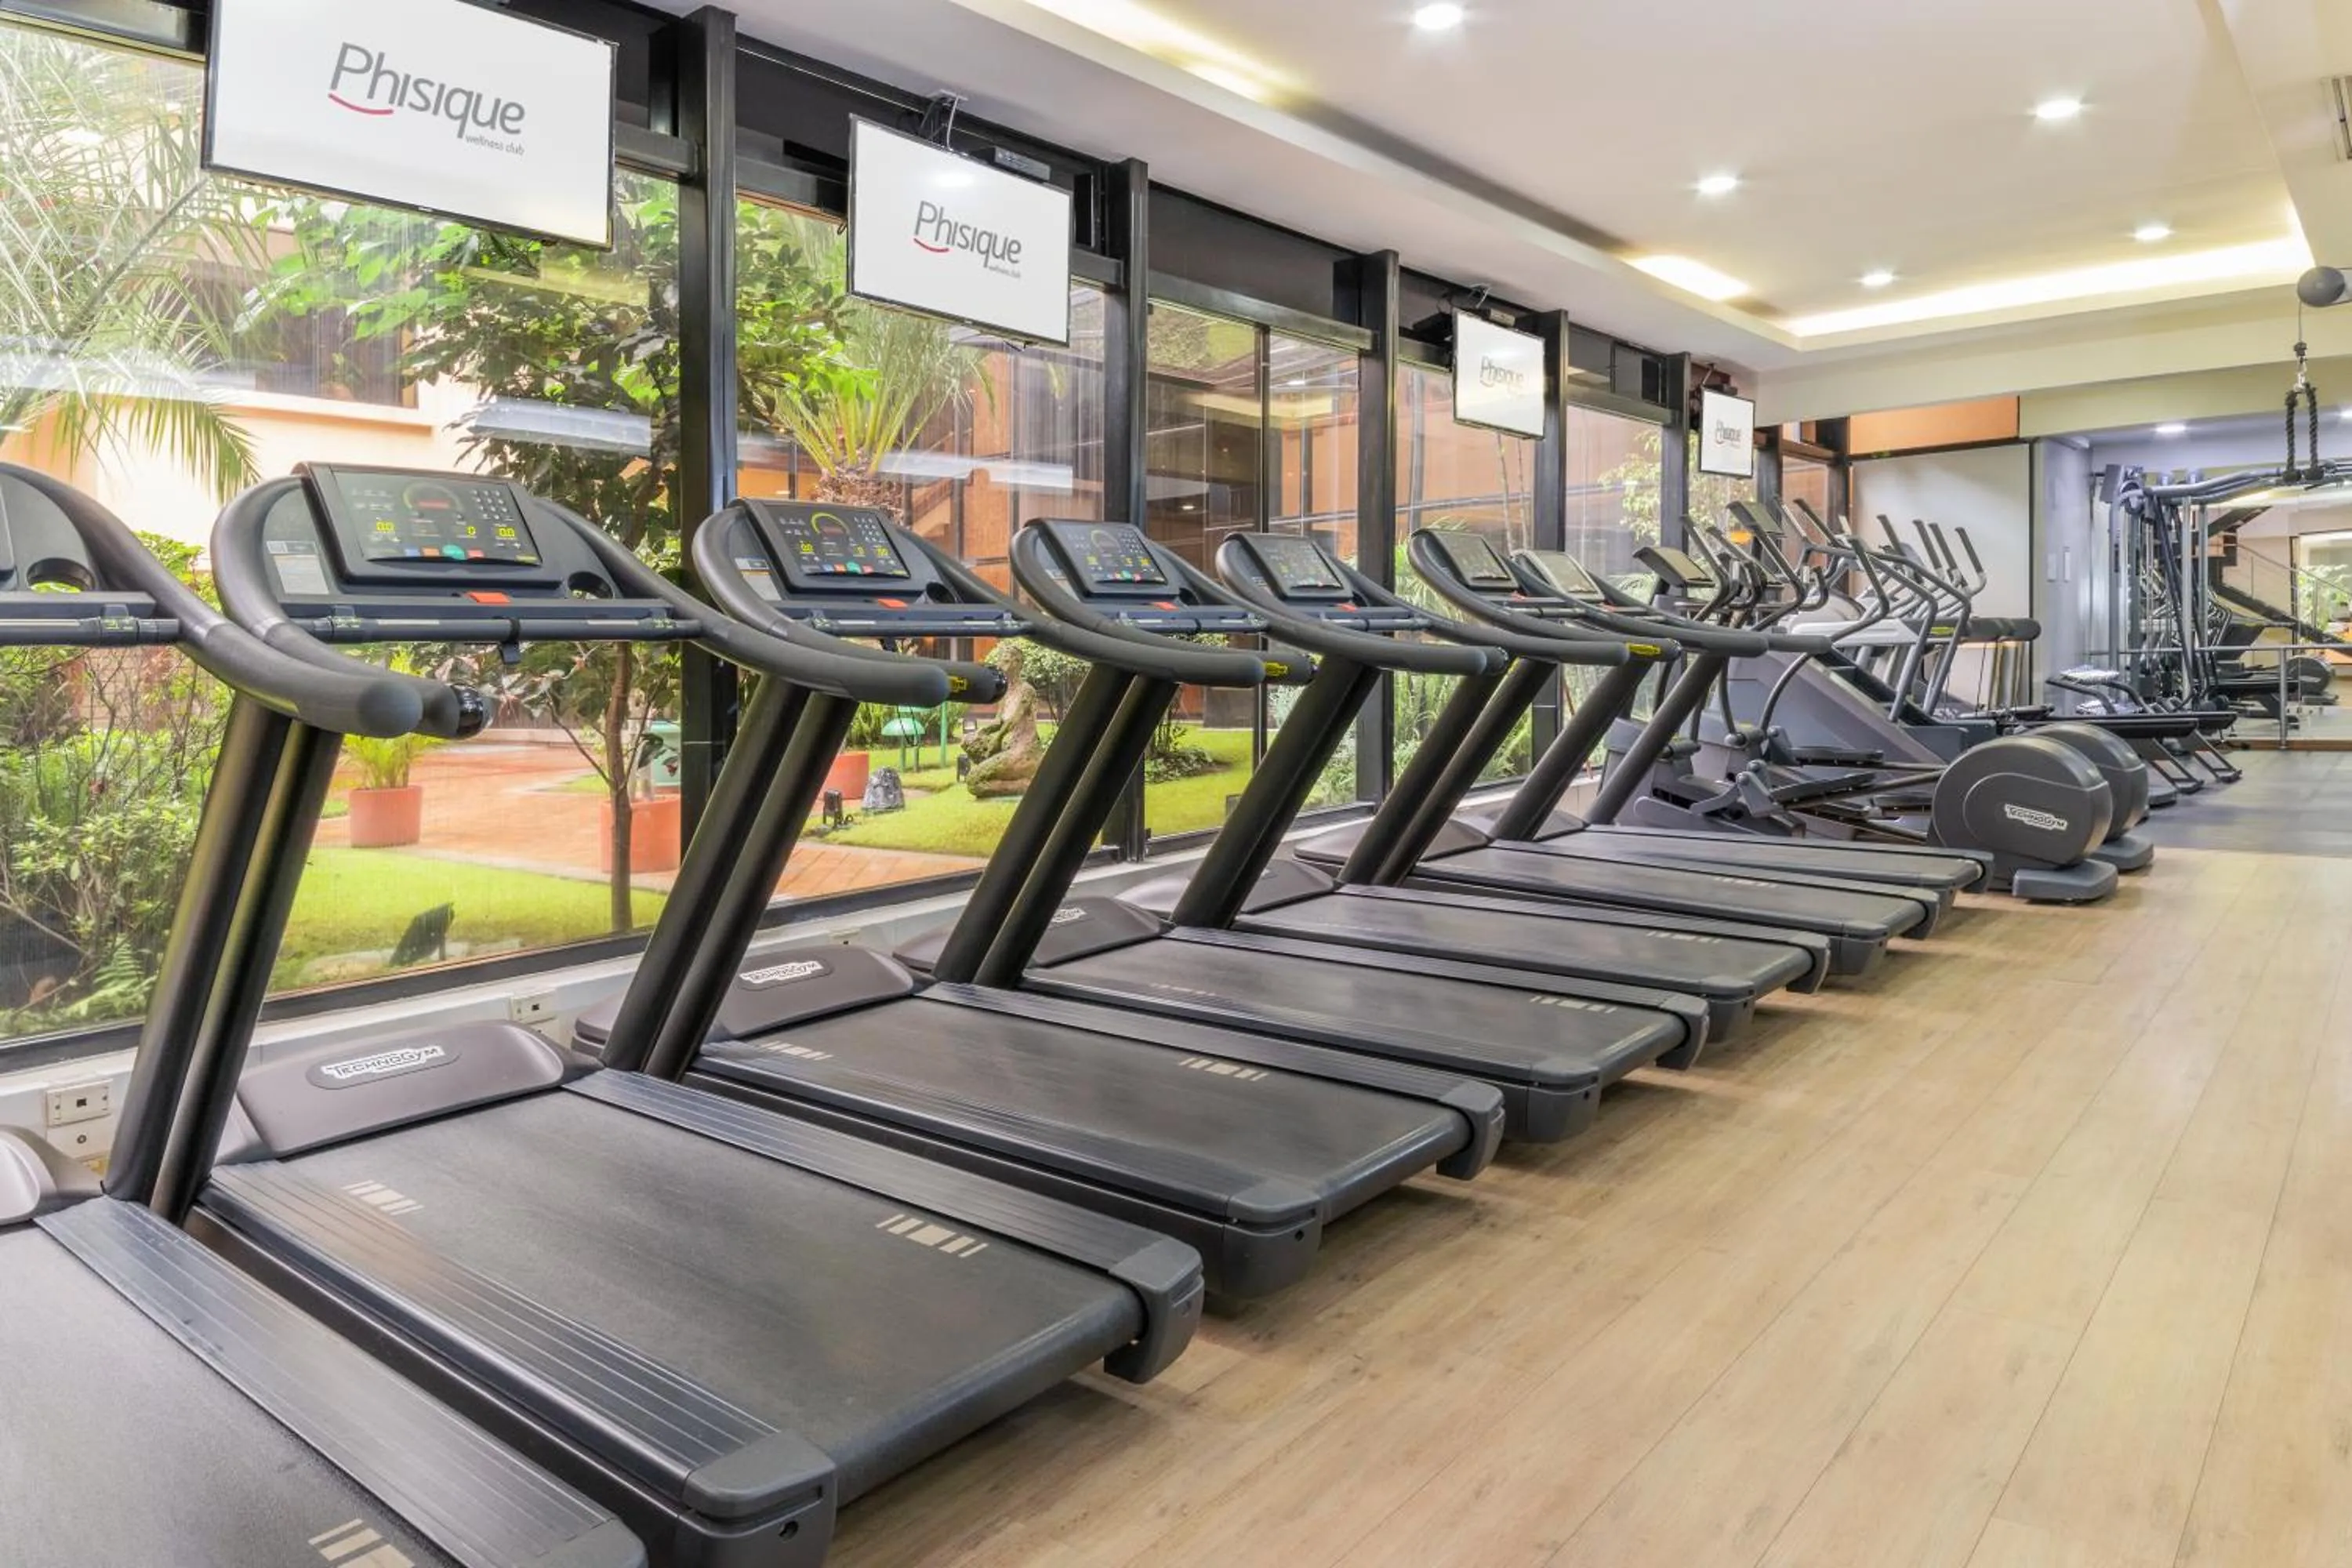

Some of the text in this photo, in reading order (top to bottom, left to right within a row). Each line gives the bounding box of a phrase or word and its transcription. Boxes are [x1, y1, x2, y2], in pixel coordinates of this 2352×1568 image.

[329, 42, 525, 139] Phisique
[465, 135, 525, 155] wellness club
[914, 200, 1022, 268] Phisique
